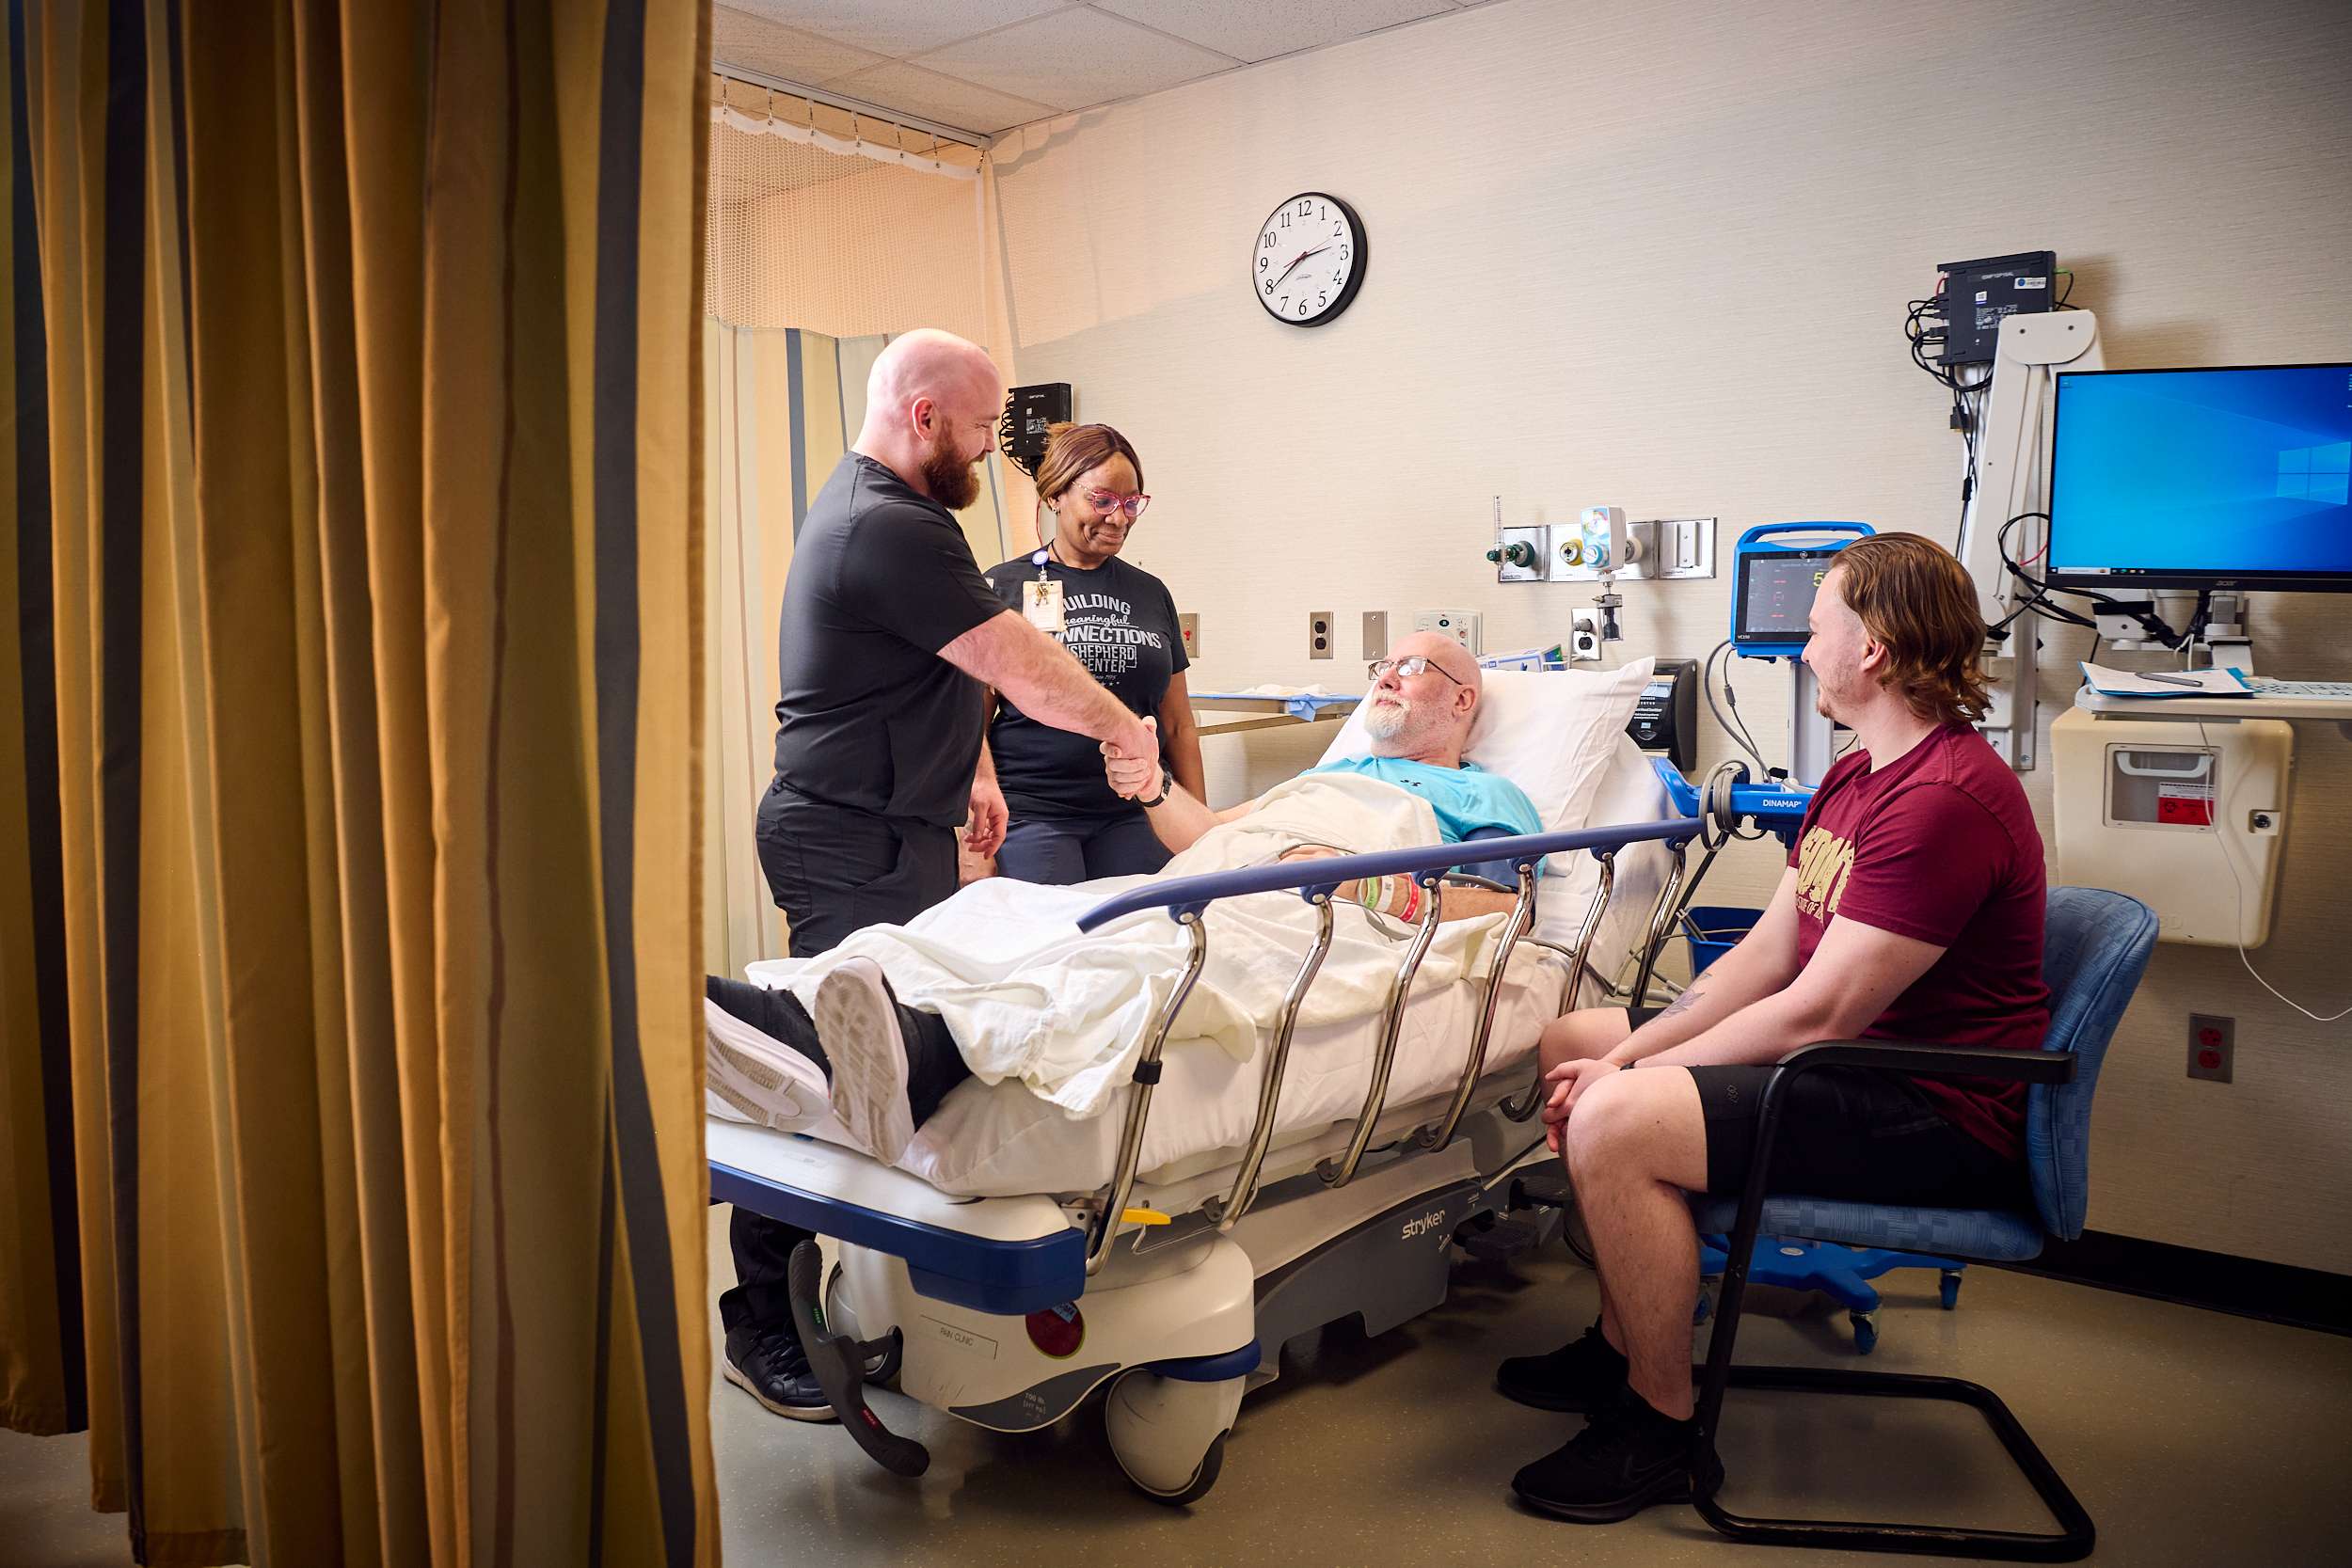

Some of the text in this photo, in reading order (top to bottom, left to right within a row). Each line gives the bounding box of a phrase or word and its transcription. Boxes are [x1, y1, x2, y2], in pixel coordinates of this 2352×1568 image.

[1297, 199, 1313, 217] 12
[1320, 205, 1326, 221] 1
[1279, 212, 1291, 228] 11
[1333, 220, 1343, 237] 2
[1263, 231, 1277, 248] 10
[1340, 244, 1349, 261] 3
[1259, 257, 1268, 274] 9
[1332, 268, 1343, 285] 4
[1264, 278, 1274, 295] 8
[1279, 295, 1289, 312] 7
[1298, 298, 1308, 315] 6
[1317, 290, 1327, 307] 5
[1063, 594, 1131, 615] UILDING
[1054, 625, 1162, 649] NNECTIONS
[1070, 644, 1135, 660] SHEPHERD
[1401, 1209, 1446, 1240] stryker
